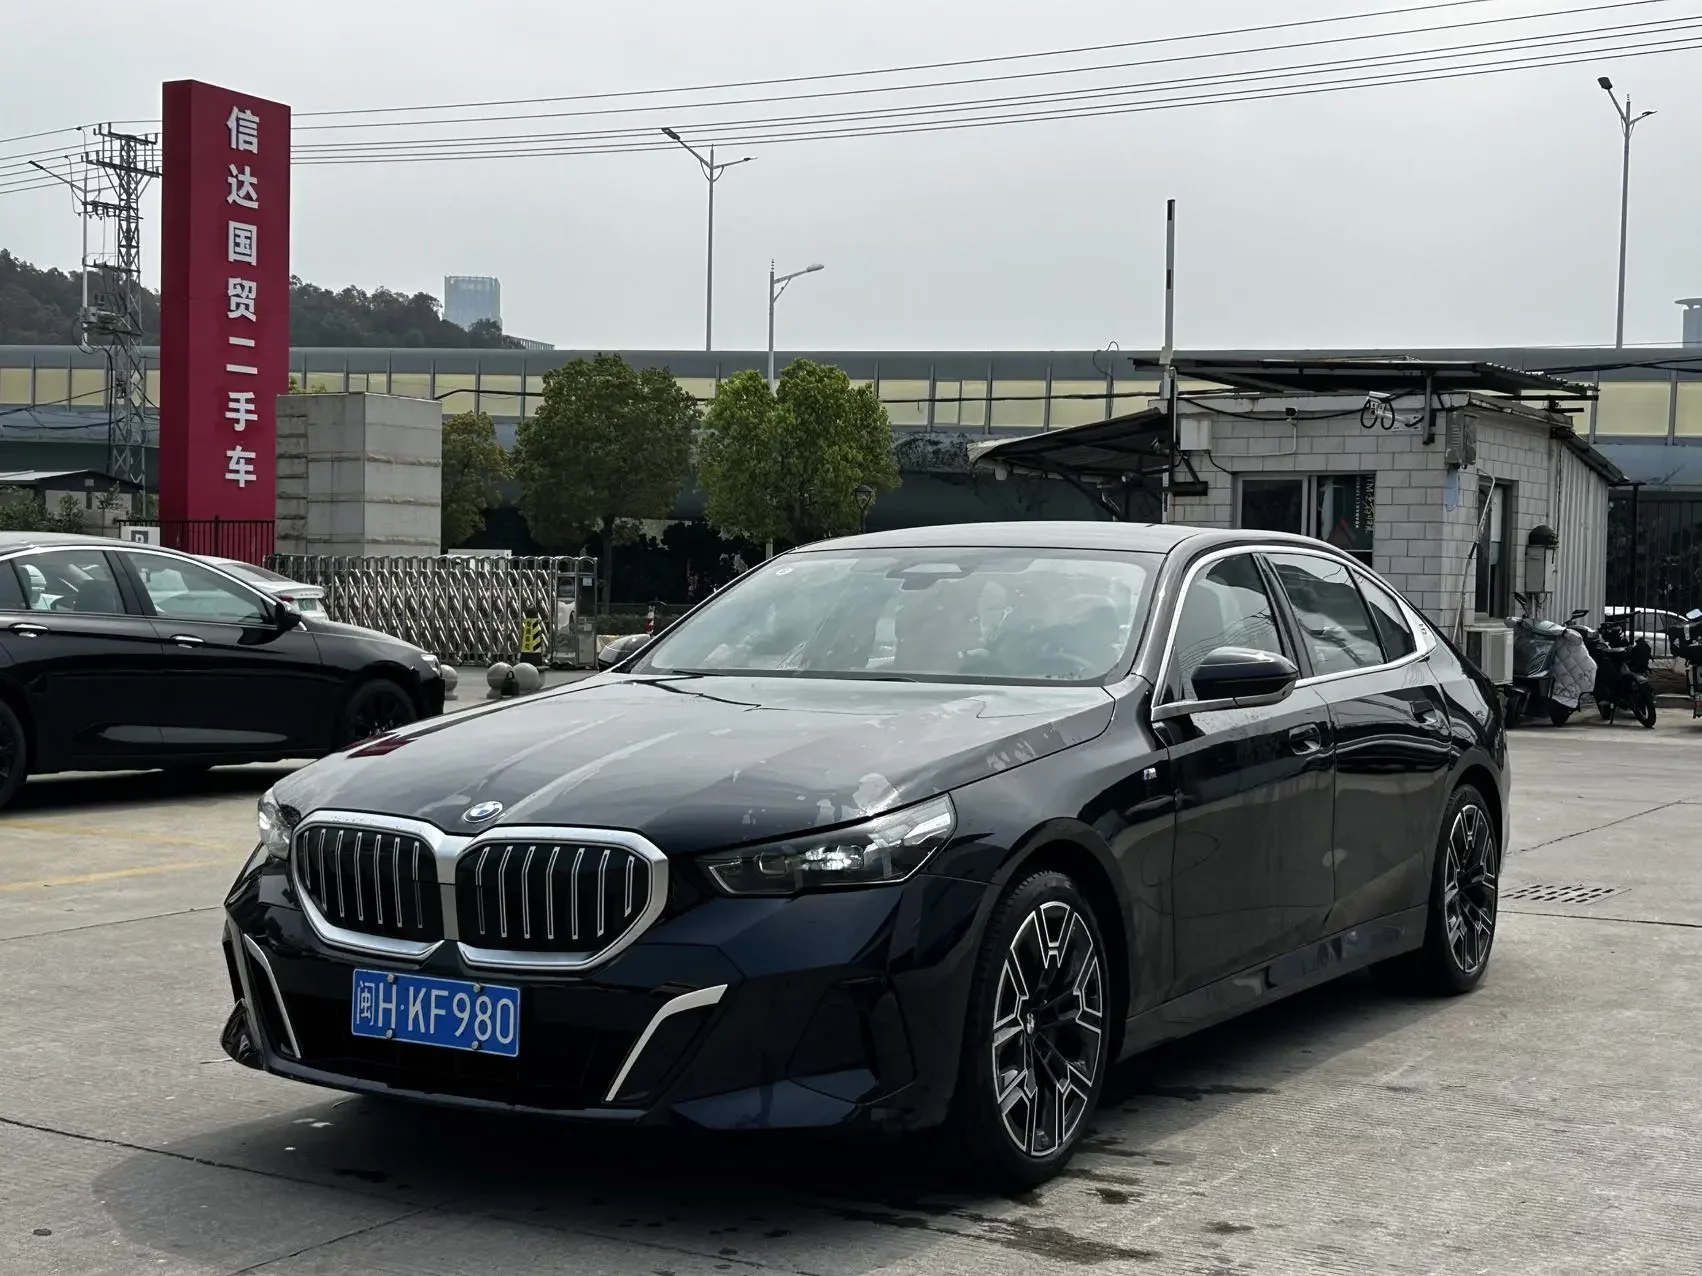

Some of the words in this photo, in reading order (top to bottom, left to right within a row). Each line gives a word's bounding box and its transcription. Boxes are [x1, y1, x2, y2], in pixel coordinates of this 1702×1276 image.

[225, 106, 260, 487] 信达国贸二手车
